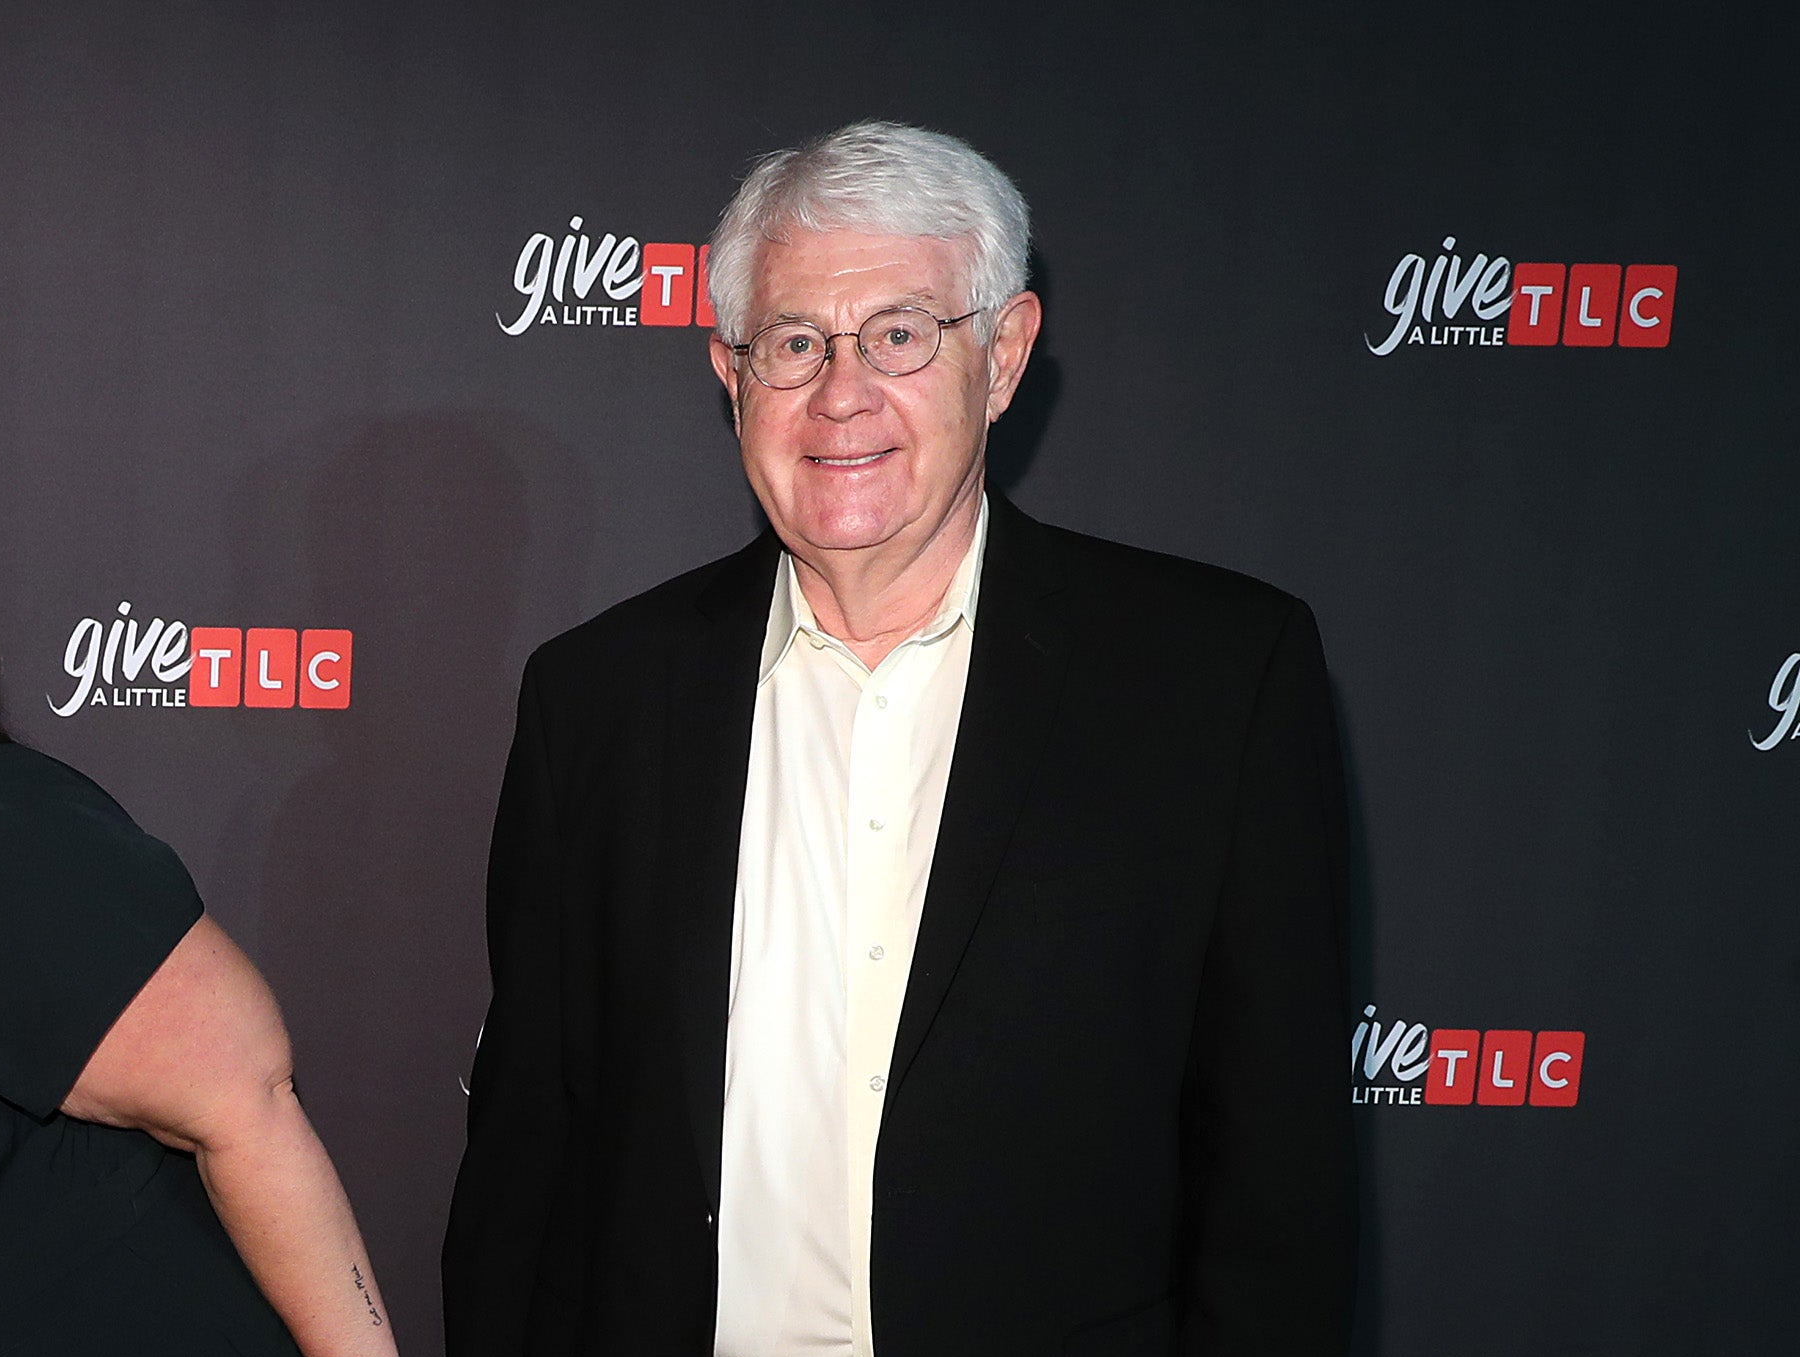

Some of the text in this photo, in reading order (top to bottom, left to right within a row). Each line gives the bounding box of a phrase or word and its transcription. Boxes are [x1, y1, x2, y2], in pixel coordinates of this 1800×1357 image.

[495, 215, 648, 336] give
[1364, 236, 1518, 356] give
[539, 305, 638, 326] A LITTLE
[1520, 285, 1664, 328] TLC
[1407, 326, 1505, 346] A LITTLE
[45, 601, 199, 717] give
[198, 648, 341, 690] TLC
[90, 687, 187, 708] A LITTLE
[1351, 1004, 1435, 1084] ive
[1437, 1049, 1572, 1089] TLC
